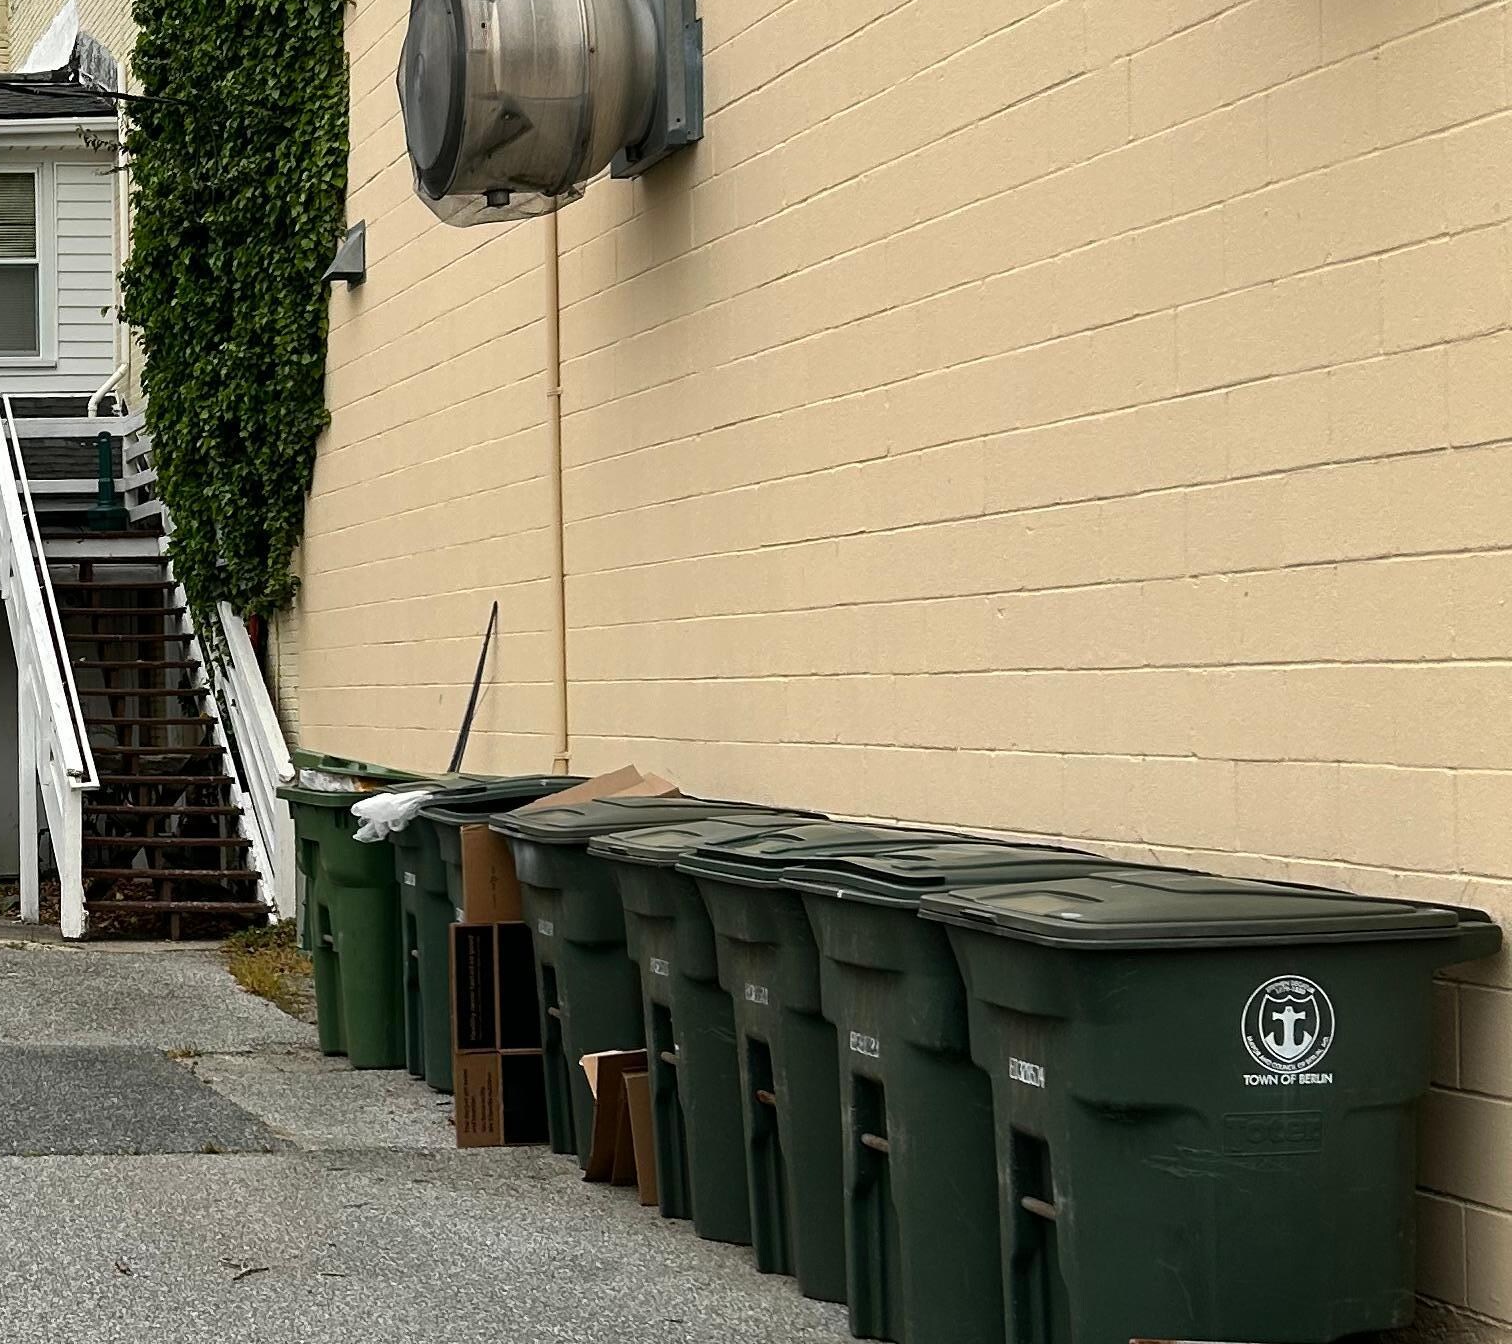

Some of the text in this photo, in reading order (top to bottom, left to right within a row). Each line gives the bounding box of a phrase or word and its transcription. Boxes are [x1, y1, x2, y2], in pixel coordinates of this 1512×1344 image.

[1243, 1073, 1333, 1085] TOWN OF BERLIN
